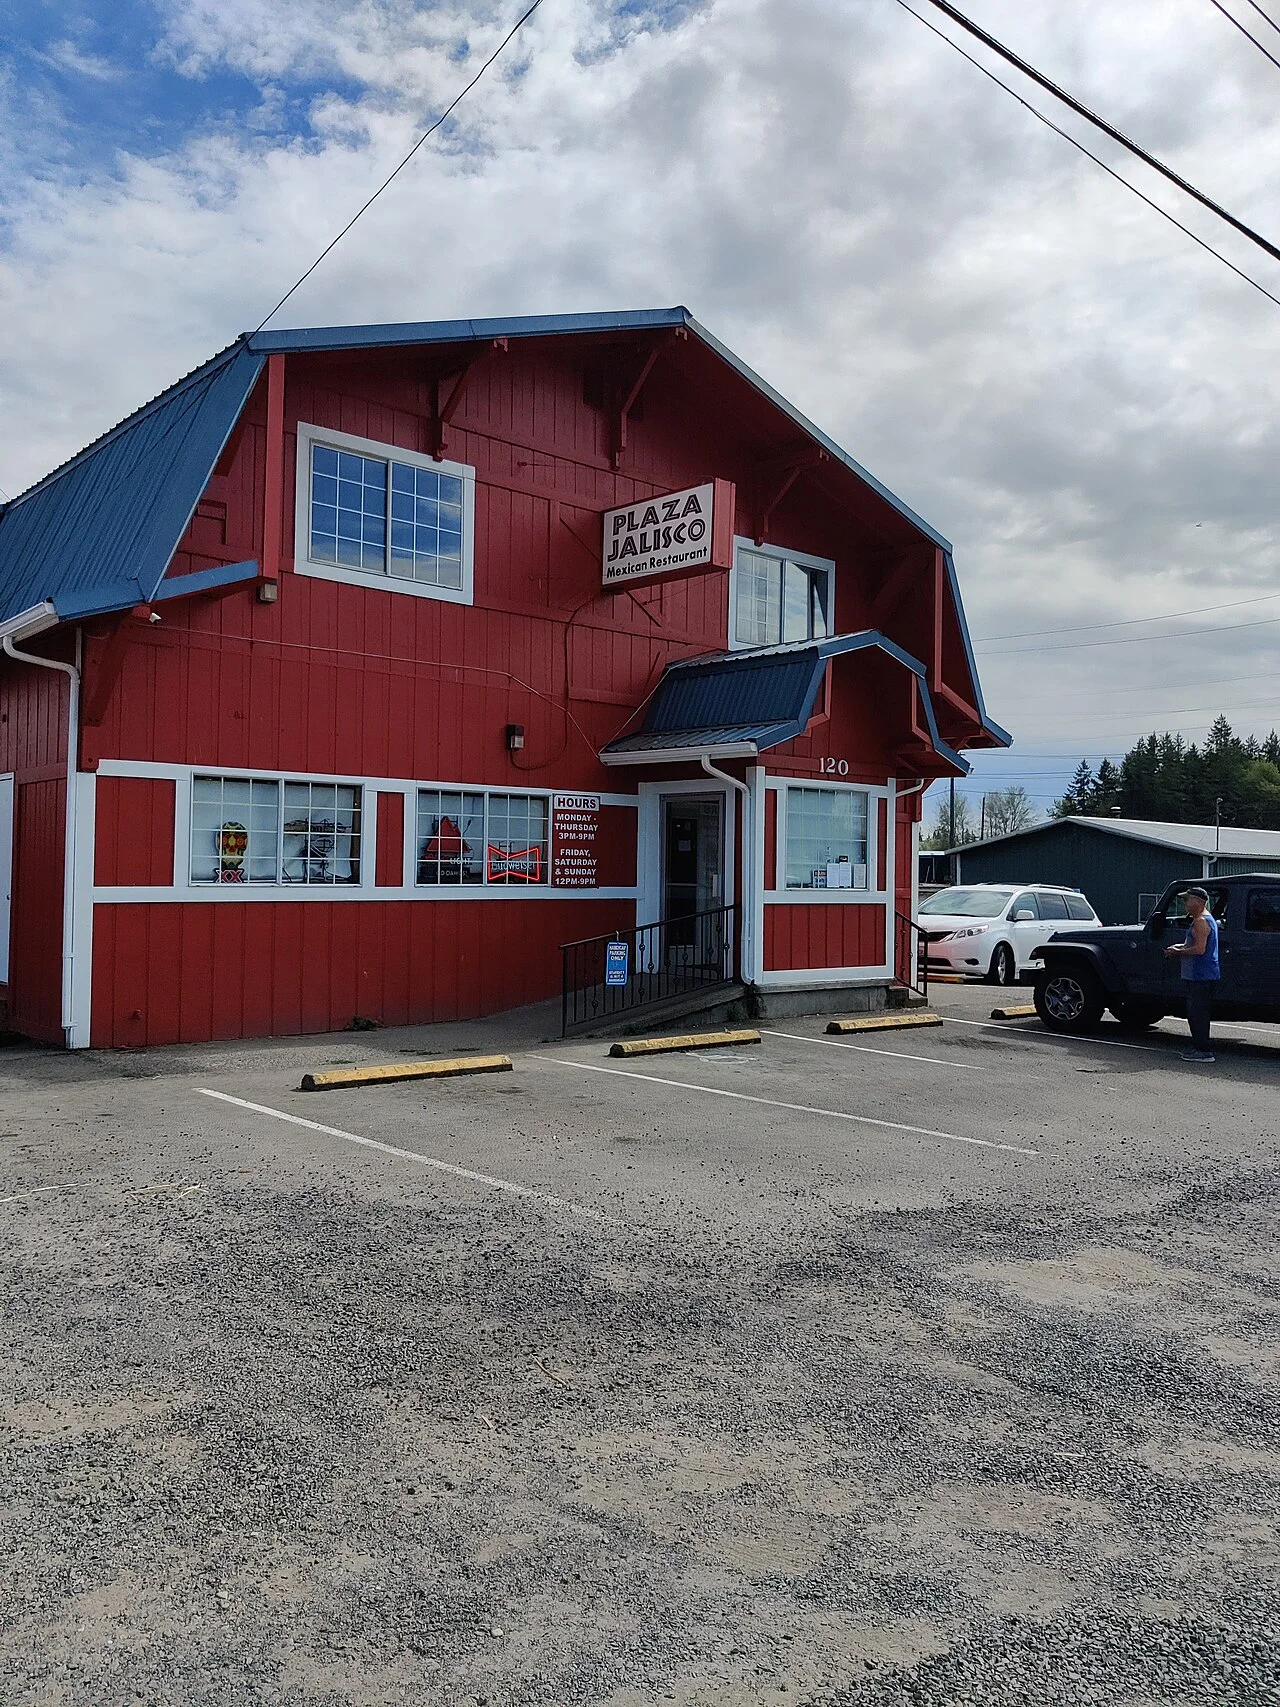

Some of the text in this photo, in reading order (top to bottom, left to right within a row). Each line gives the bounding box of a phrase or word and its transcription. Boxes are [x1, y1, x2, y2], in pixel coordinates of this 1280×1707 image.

[612, 494, 702, 536] PLAZA
[607, 519, 705, 562] JALISCO
[607, 546, 708, 578] Mexican Restaurant
[820, 757, 849, 776] 120
[557, 797, 597, 809] HOURS
[556, 813, 592, 822] MONDAY
[554, 823, 599, 832] THURSDAY
[560, 848, 591, 857] FRIDAY,
[491, 859, 535, 871] Budweiser
[554, 858, 598, 866] SATURDAY
[564, 868, 597, 876] SUNDAY
[555, 877, 596, 885] 12PM-9PM
